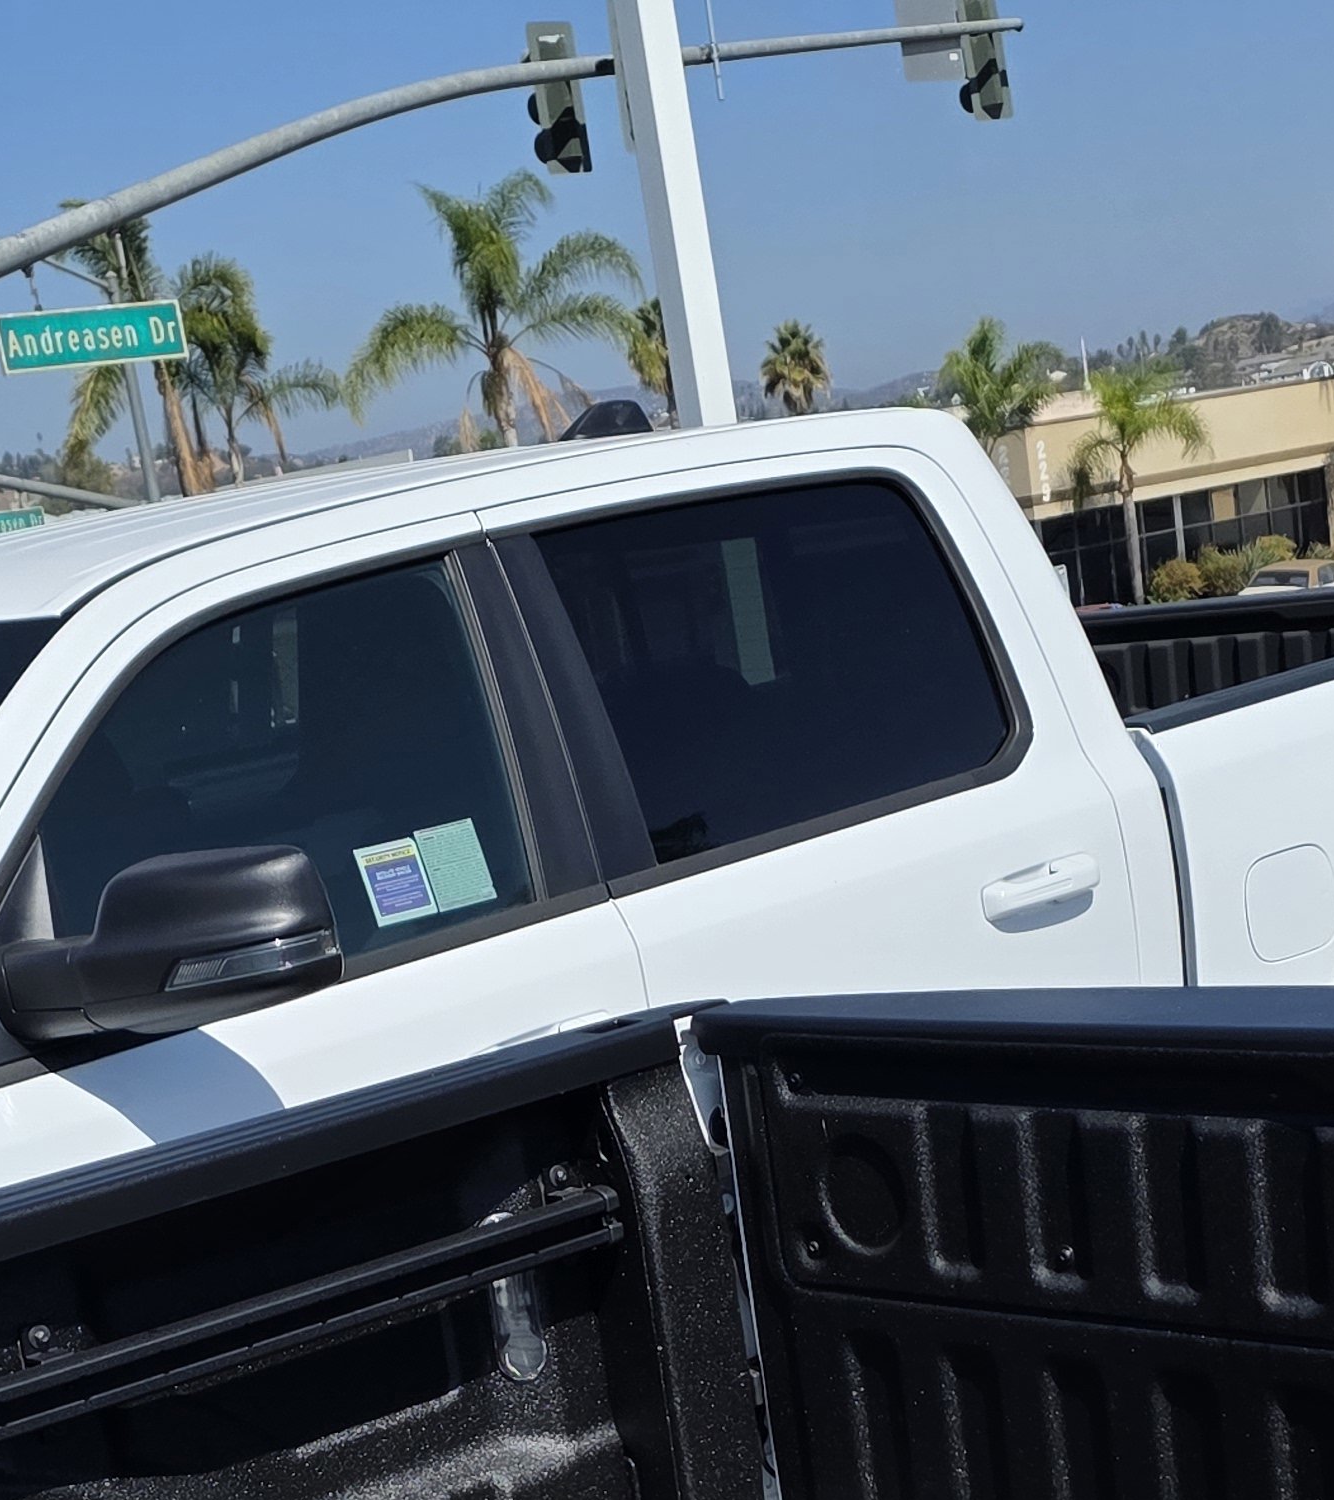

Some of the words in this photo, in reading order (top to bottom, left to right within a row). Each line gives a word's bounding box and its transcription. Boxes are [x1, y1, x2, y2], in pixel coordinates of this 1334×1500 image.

[8, 323, 139, 359] Andreasen
[148, 315, 176, 345] Dr
[1036, 439, 1051, 502] 229
